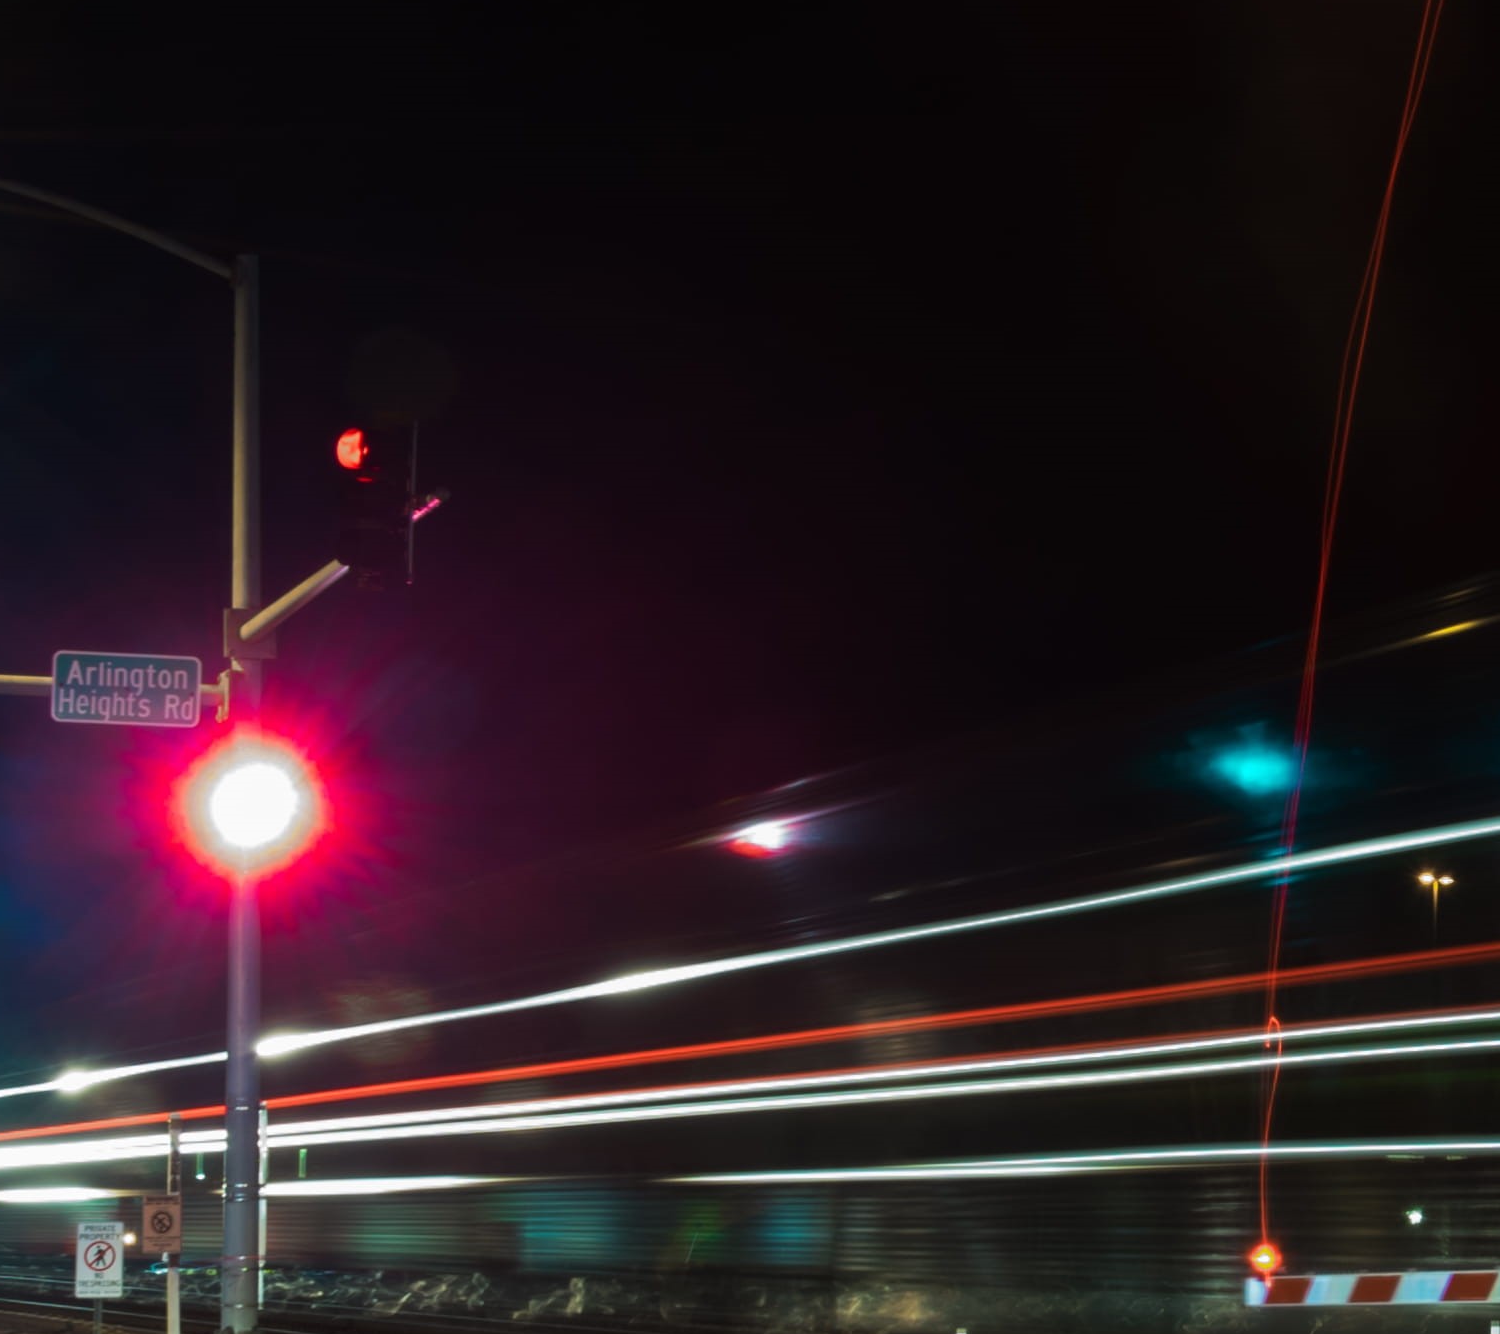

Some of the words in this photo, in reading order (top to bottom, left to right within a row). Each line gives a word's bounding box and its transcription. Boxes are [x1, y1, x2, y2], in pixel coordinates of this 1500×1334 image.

[66, 659, 189, 696] Arlington
[57, 688, 151, 722] Heights
[163, 693, 194, 721] Rd
